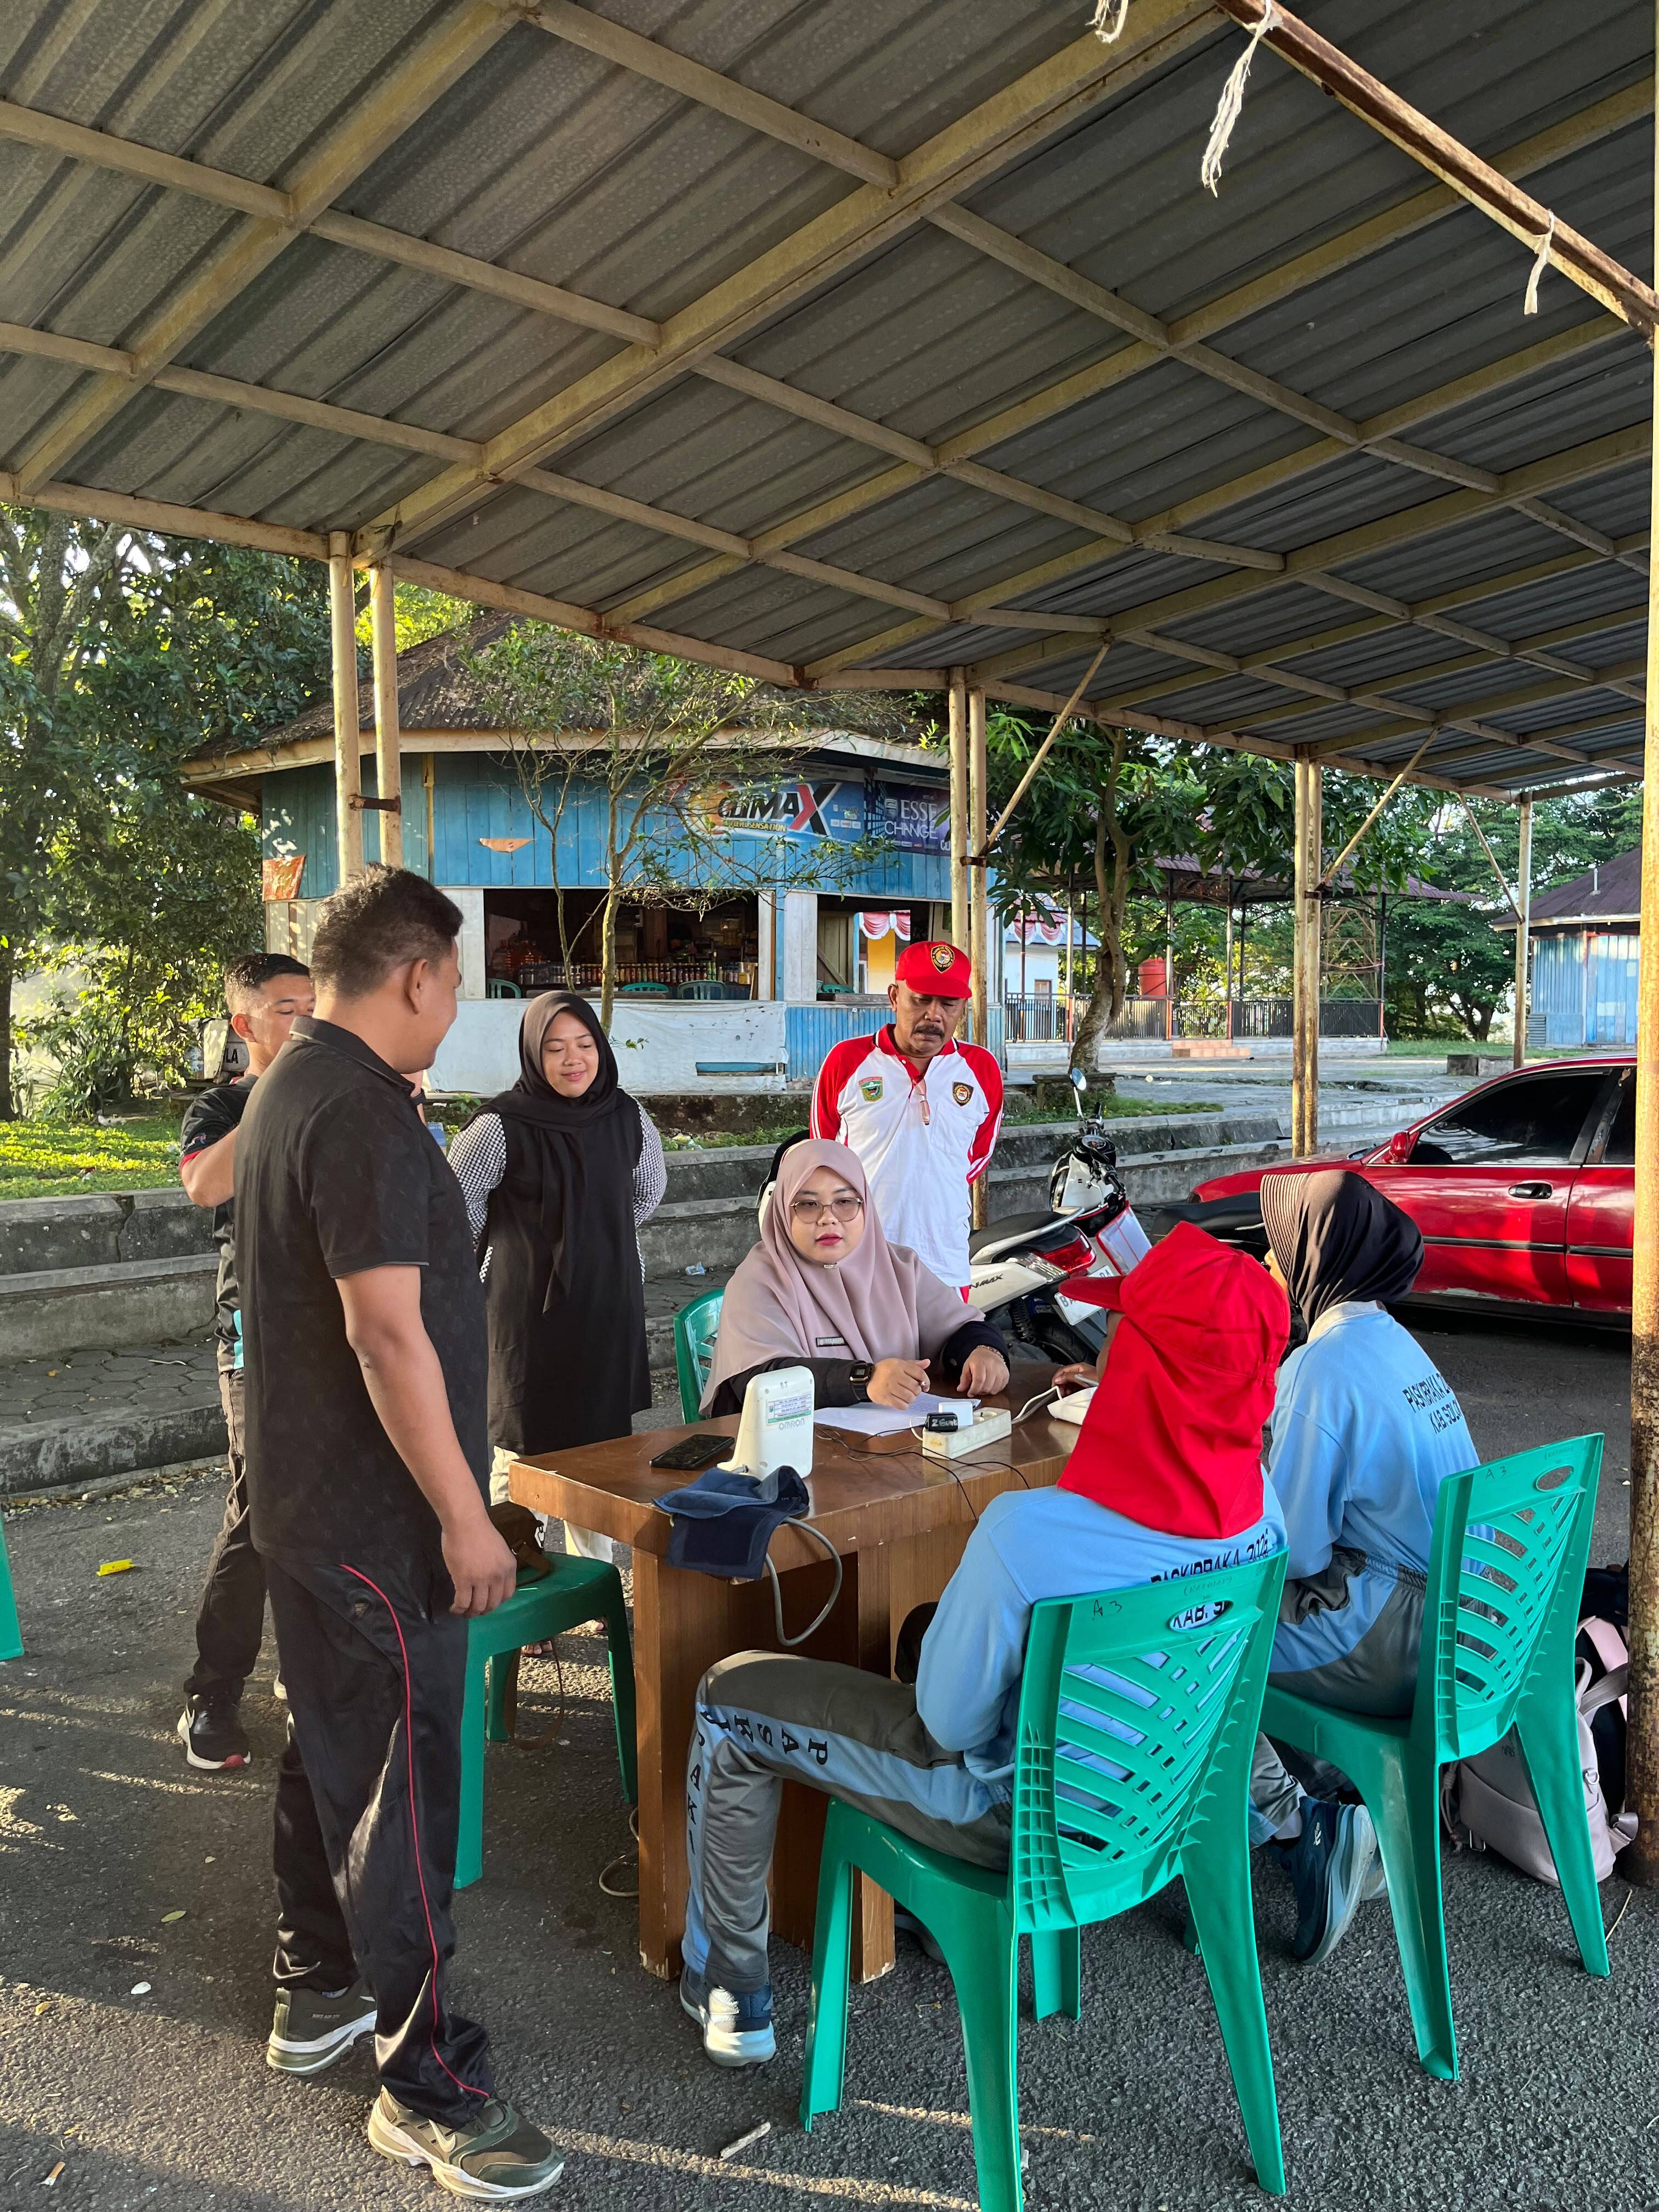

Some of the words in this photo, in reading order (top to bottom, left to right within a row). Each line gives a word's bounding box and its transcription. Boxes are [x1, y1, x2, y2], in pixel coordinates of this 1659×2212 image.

[900, 799, 938, 823] ESSE
[749, 821, 787, 832] SENSATION
[884, 820, 938, 839] CHANGE
[778, 1417, 805, 1431] OMRON
